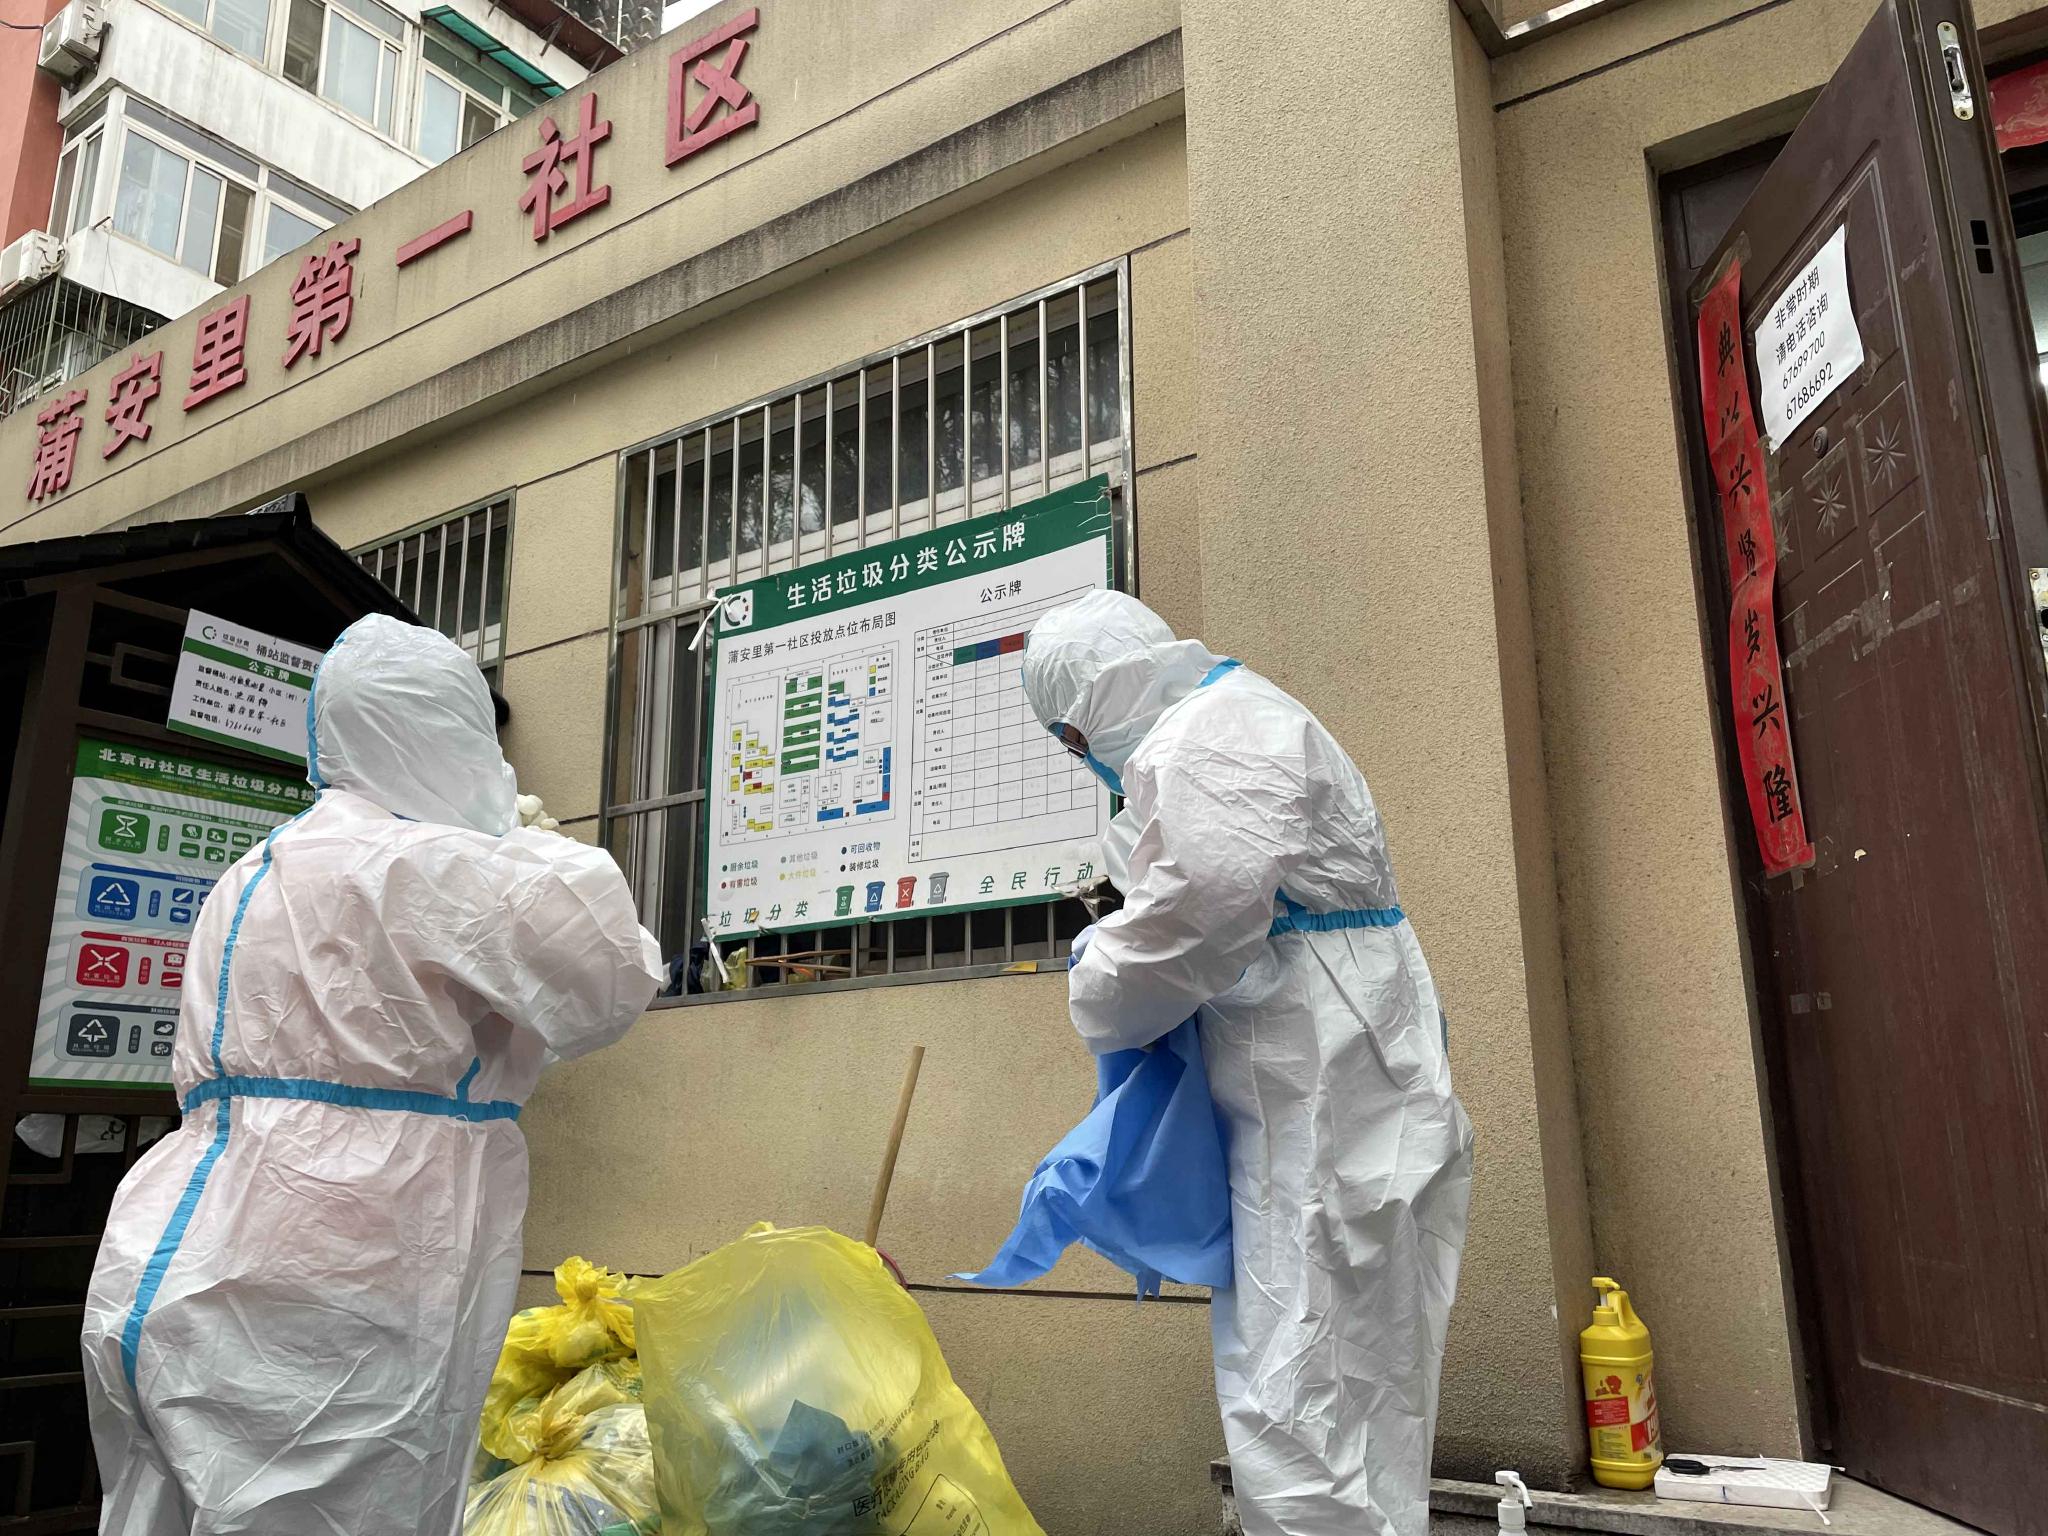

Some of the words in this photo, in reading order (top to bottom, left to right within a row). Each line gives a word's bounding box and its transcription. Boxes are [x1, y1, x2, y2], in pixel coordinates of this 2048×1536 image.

[27, 7, 760, 501] 蒲安里第一社区
[1774, 266, 1821, 331] 非常时期
[1775, 293, 1829, 366] 请电话咨询
[1782, 331, 1826, 390] 67699700
[1786, 362, 1834, 421] 67686692
[786, 521, 1026, 610] 生活垃圾分类公示牌
[979, 579, 1022, 604] 公示牌
[727, 611, 896, 664] 蒲安里第一社区投放点位布局图
[248, 660, 290, 682] 公示牌
[849, 859, 879, 872] 装修垃圾
[850, 841, 881, 855] 可回收物
[978, 861, 1093, 894] 全民行动
